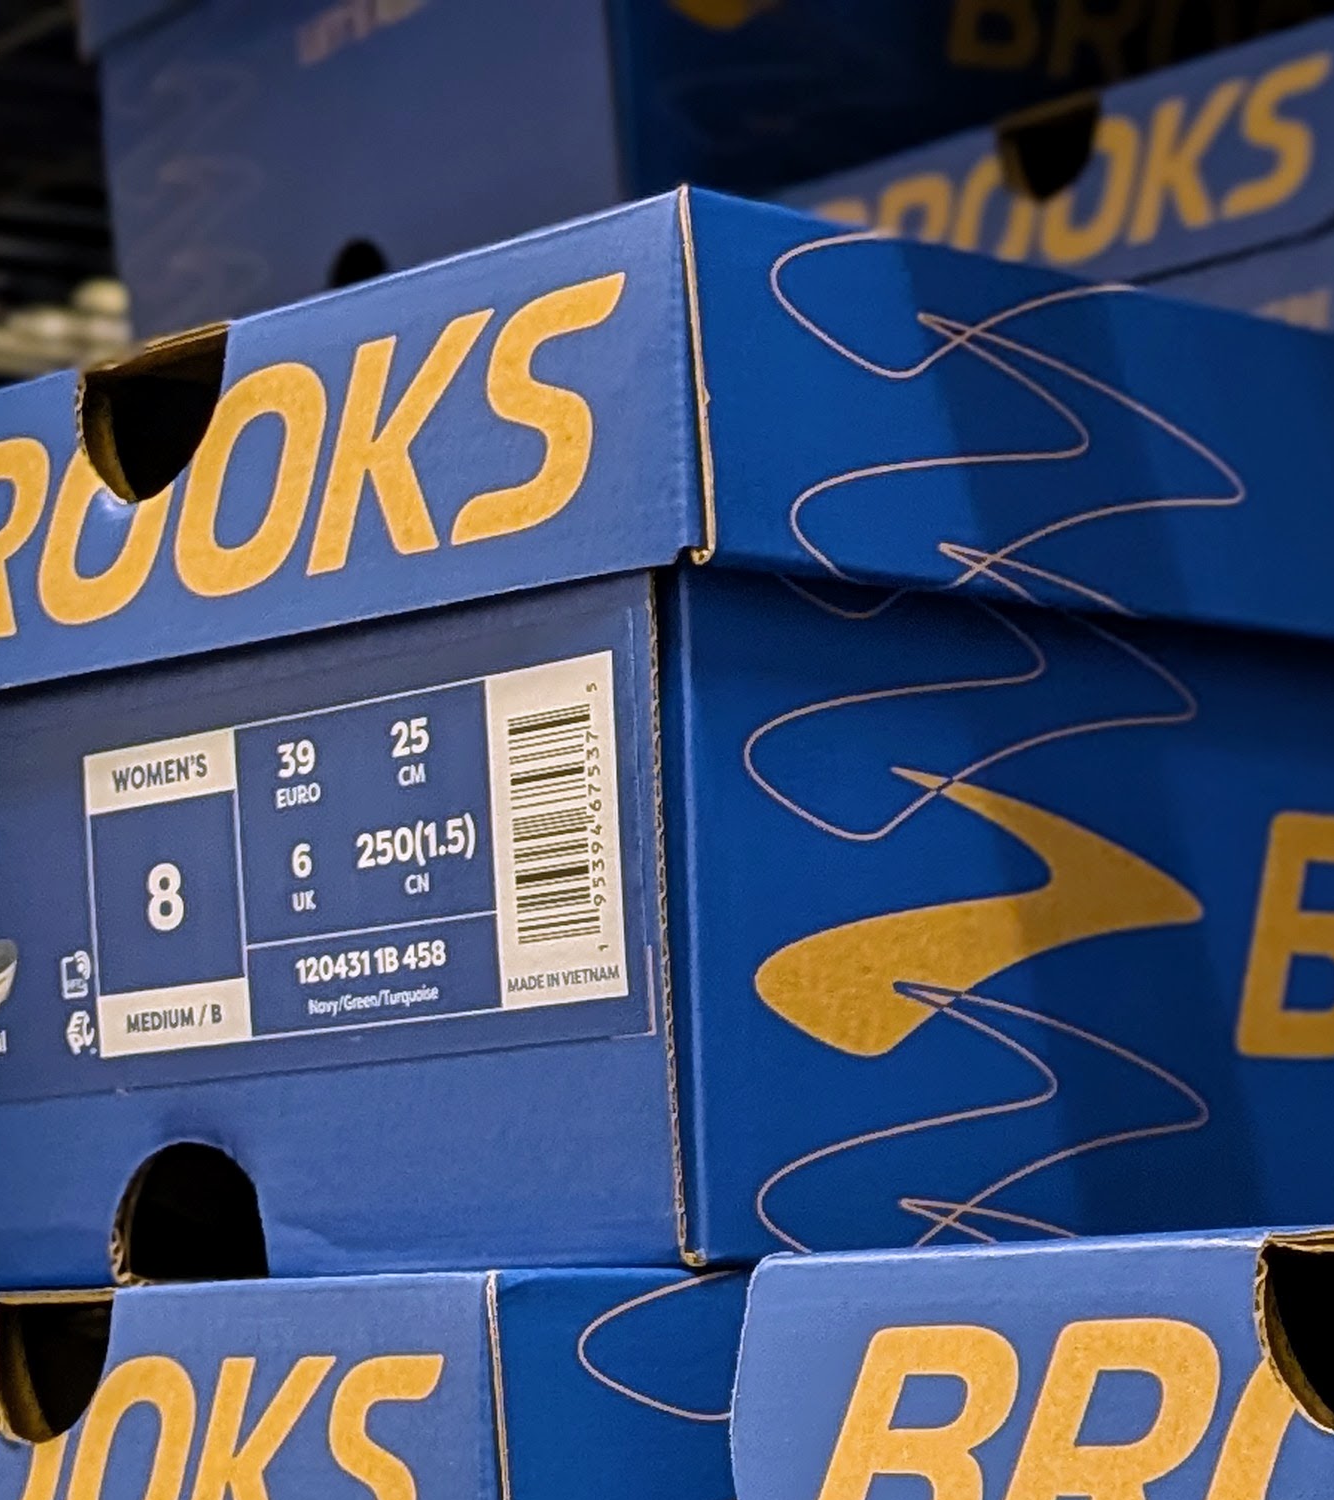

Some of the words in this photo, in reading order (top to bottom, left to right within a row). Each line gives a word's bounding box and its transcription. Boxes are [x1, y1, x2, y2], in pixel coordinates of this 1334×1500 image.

[277, 740, 315, 778] 39
[390, 717, 429, 757] 25
[112, 753, 208, 793] WOMEN'S
[275, 782, 321, 809] EURO
[398, 763, 426, 786] CM
[292, 843, 312, 878] 6
[356, 812, 475, 868] 250(1.5)
[148, 863, 185, 931] 8
[292, 890, 316, 911] UK
[405, 872, 429, 894] CN
[295, 950, 370, 985] 120431
[373, 947, 398, 974] 1B
[403, 939, 446, 969] 458
[507, 972, 545, 992] MADE
[547, 971, 560, 988] IN
[562, 965, 620, 986] VIETNAM
[126, 1005, 195, 1034] MEDIUM
[211, 1004, 222, 1024] B
[308, 984, 439, 1017] Navy/Green/Turquoise
